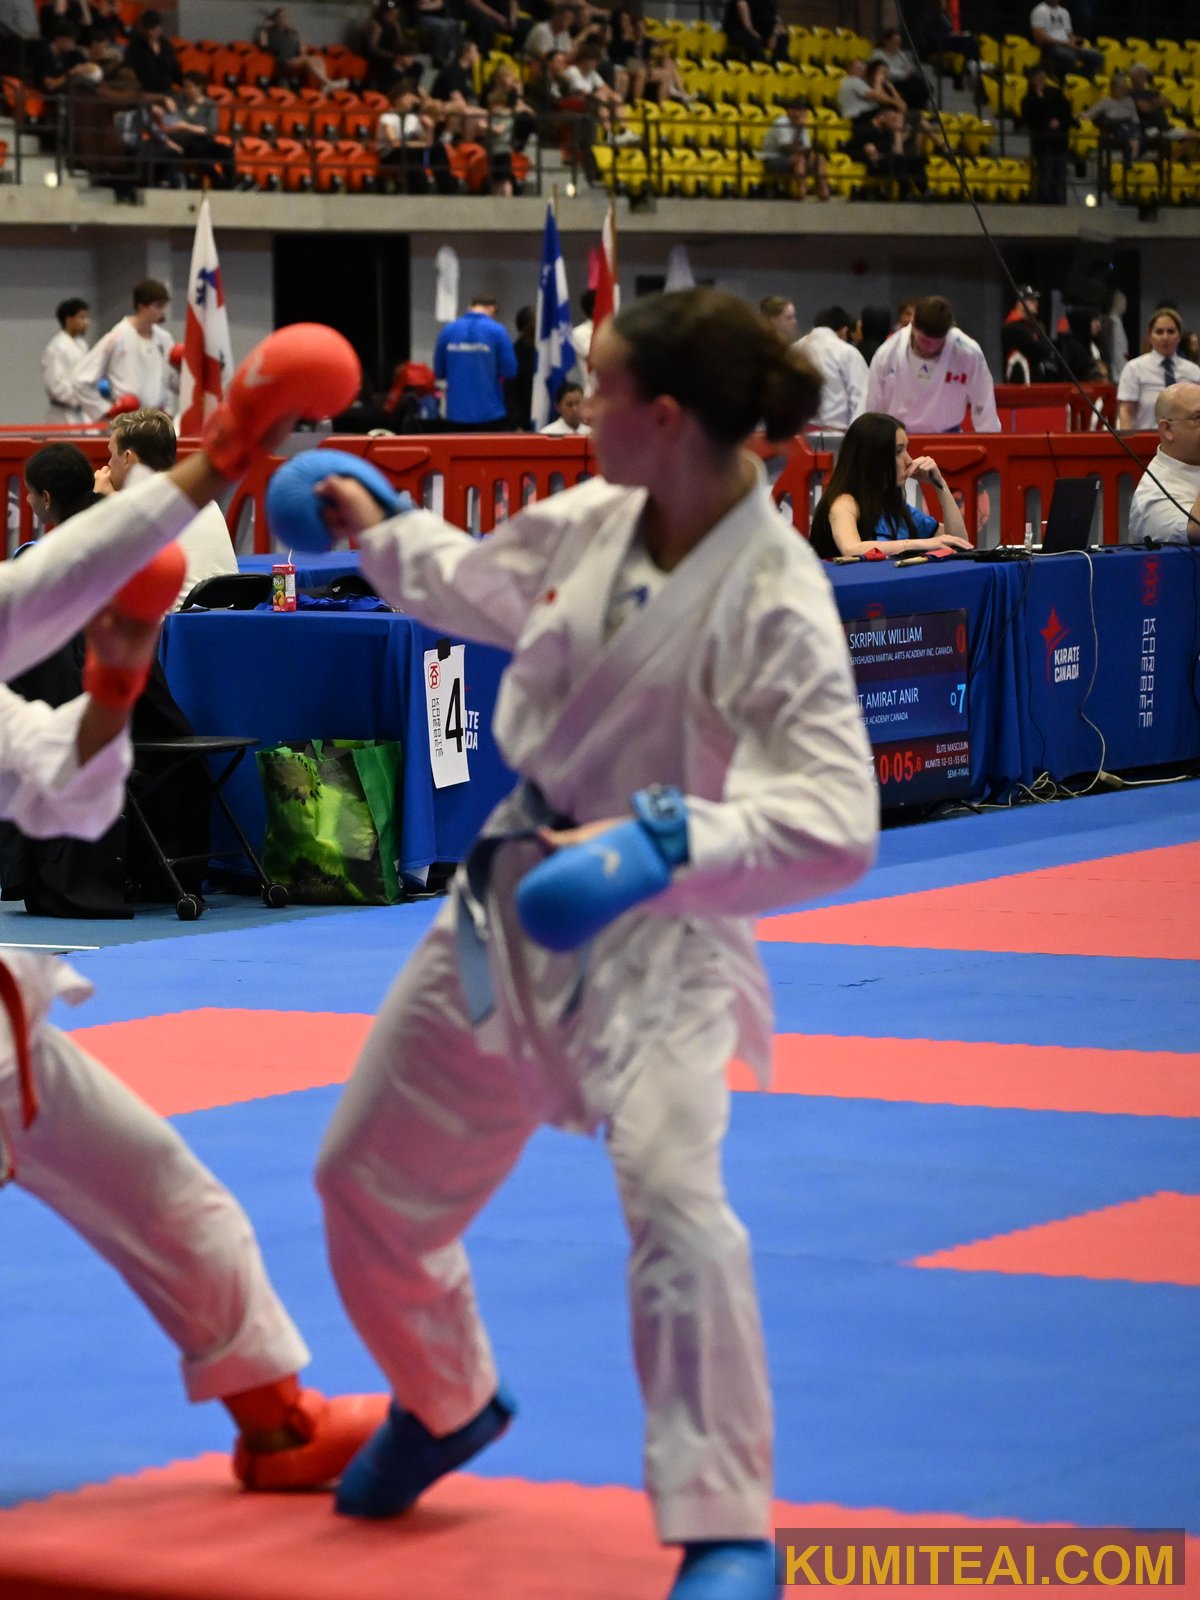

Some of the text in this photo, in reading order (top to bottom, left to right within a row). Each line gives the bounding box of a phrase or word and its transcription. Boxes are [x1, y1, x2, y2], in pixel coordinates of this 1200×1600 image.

[849, 626, 923, 649] SKRIPNIK WILLIAM
[875, 653, 893, 663] MARTIAL
[894, 652, 905, 660] ARTS
[906, 648, 926, 659] ACADEMY
[935, 646, 953, 655] CANADA
[1054, 645, 1080, 666] KARATE
[1054, 663, 1079, 683] CANADA
[866, 690, 898, 709] AMIRAT
[899, 687, 919, 704] ANIR
[957, 683, 966, 714] 7
[445, 677, 464, 753] 4
[869, 714, 890, 725] ACADEMY
[890, 712, 909, 722] CANADA
[925, 759, 940, 768] KUMITE
